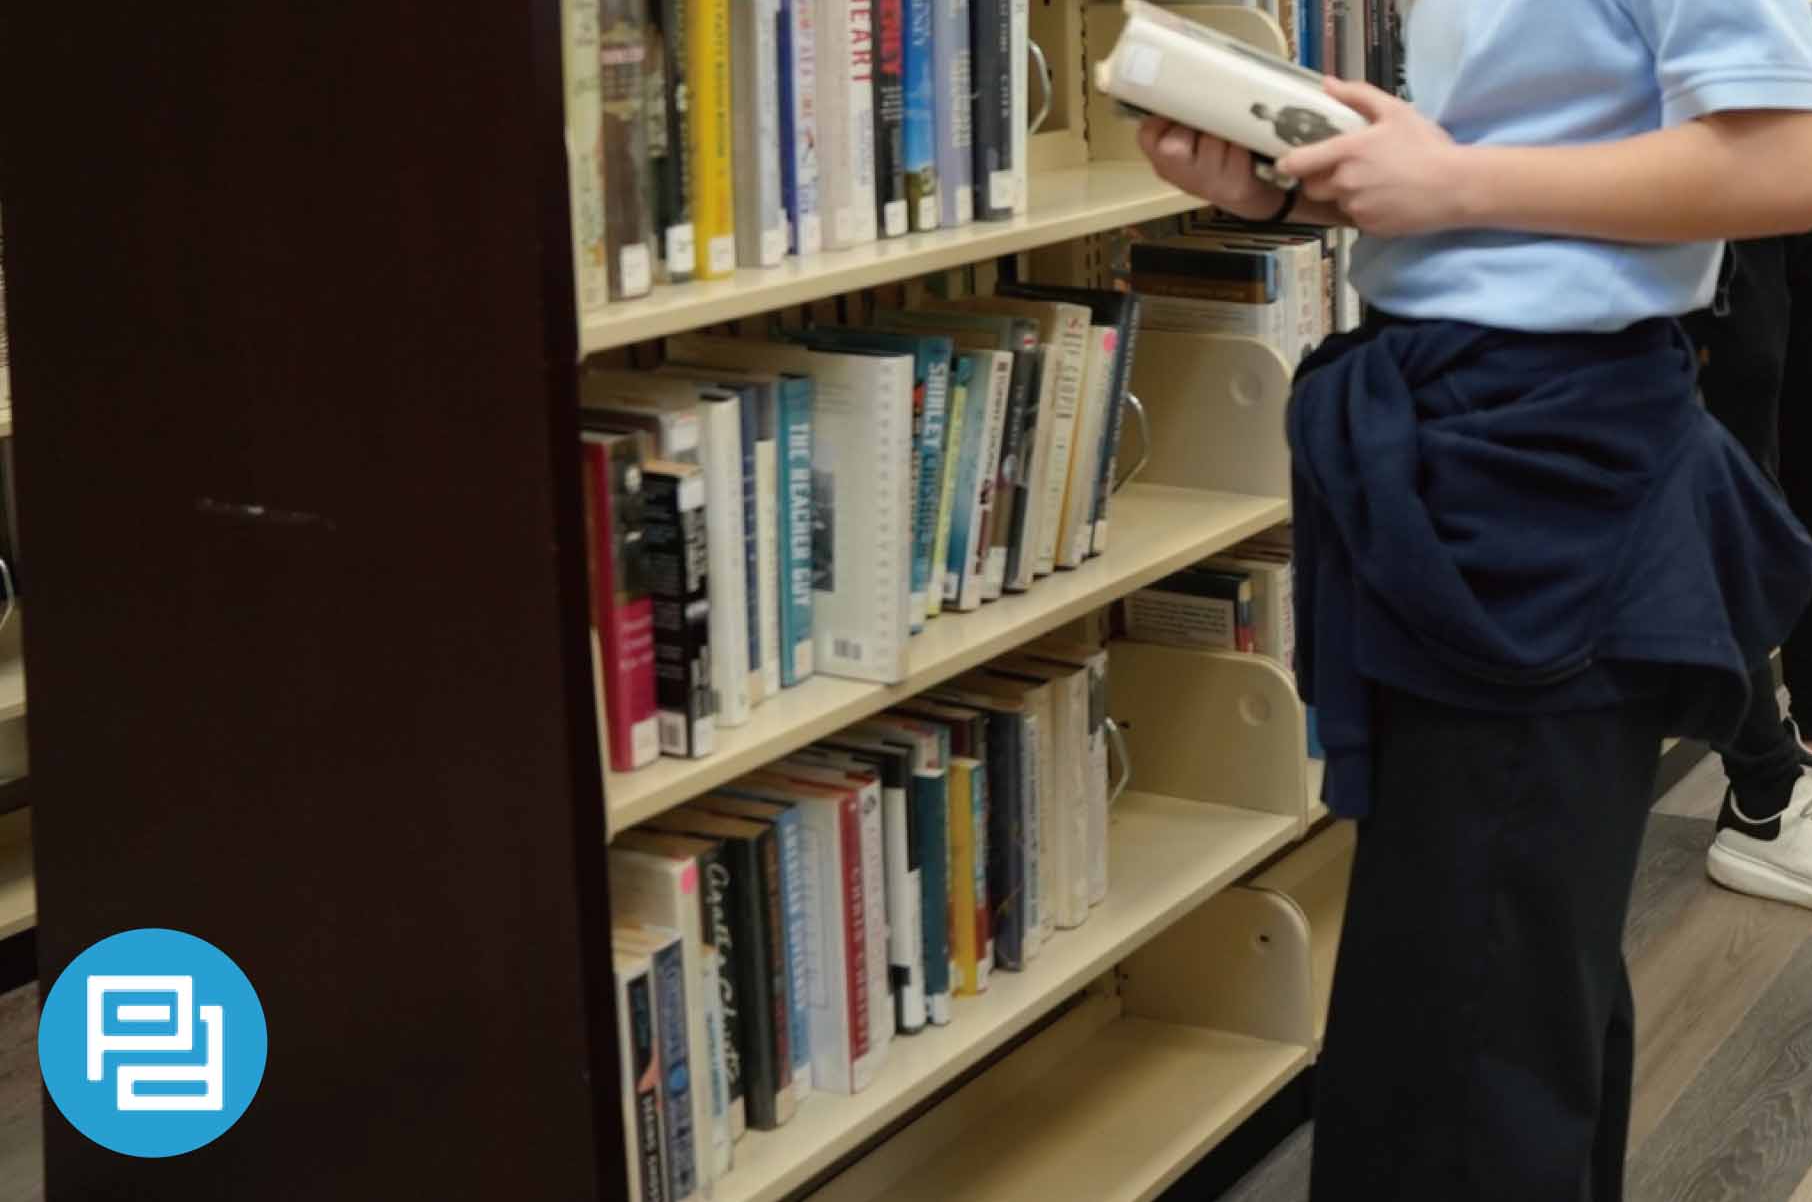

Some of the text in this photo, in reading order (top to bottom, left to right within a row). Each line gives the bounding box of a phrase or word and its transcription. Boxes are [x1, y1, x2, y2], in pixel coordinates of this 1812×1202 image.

[923, 362, 946, 448] SHIRLEY
[789, 423, 812, 606] THE REACHER GUY
